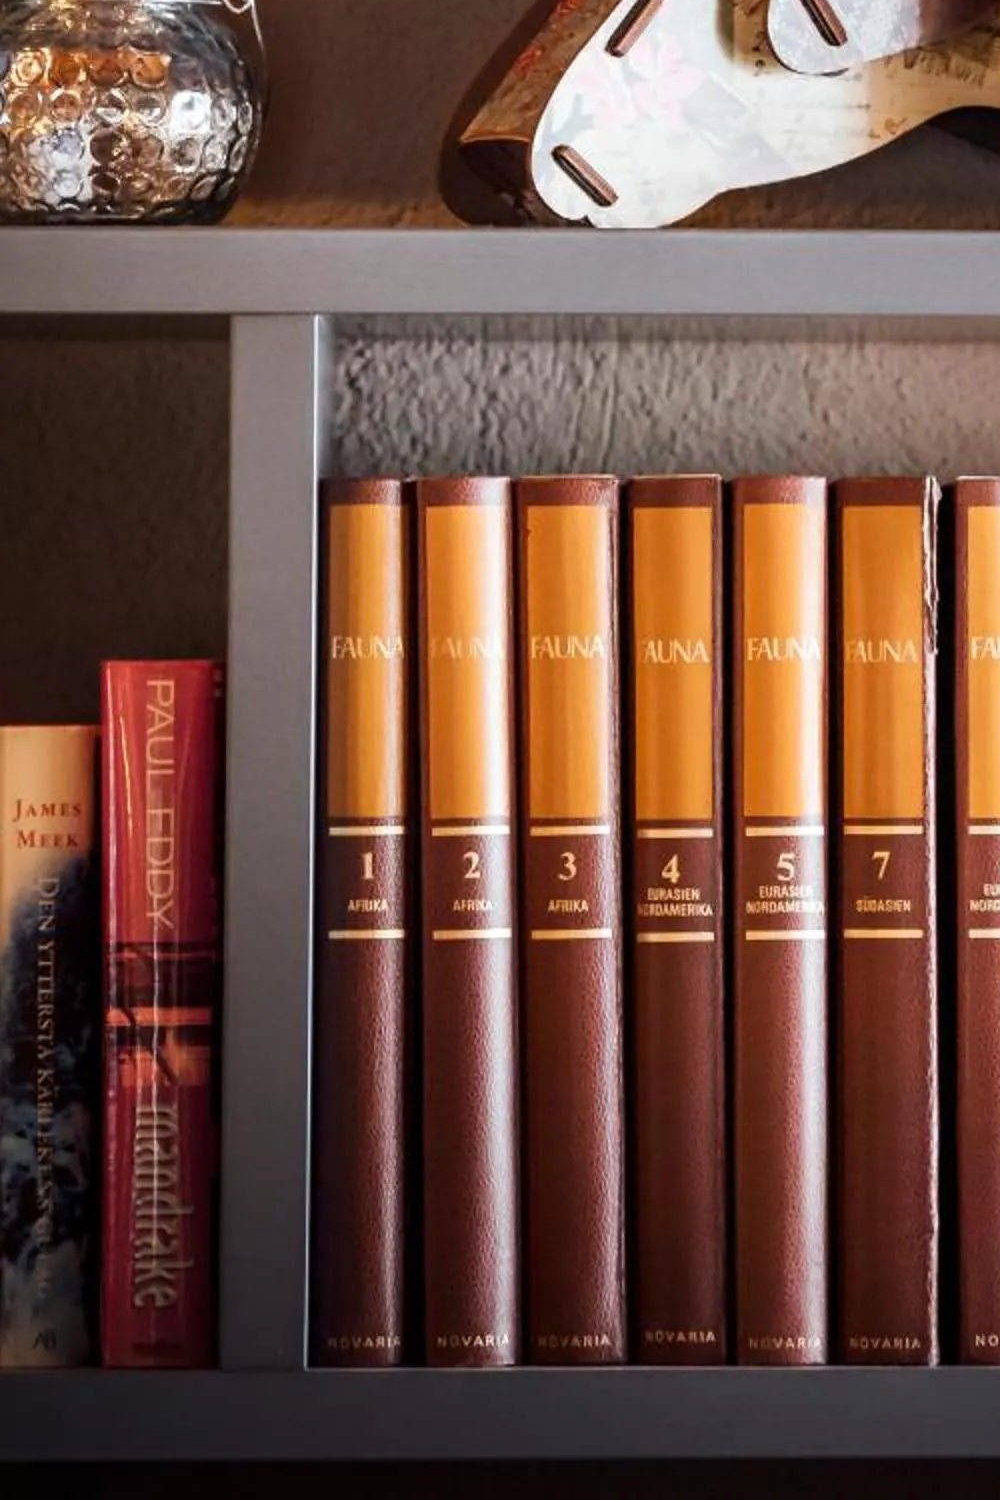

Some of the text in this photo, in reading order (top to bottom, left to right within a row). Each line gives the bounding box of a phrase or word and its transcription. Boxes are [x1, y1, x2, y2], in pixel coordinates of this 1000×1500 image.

[331, 635, 405, 660] FAUNA
[430, 635, 505, 660] FAUN
[530, 635, 606, 659] FAUNA
[641, 638, 710, 664] AUNA
[746, 636, 822, 661] FAUNA
[845, 638, 918, 663] FAUNA
[146, 680, 175, 929] PAUL EDDY
[361, 852, 375, 880] 1
[463, 851, 481, 879] 2
[558, 852, 577, 880] 3
[661, 853, 680, 884] 4
[776, 852, 796, 881] 5
[871, 851, 891, 880] 7
[347, 898, 390, 913] AFRIKA
[452, 898, 495, 913] AFRIKA
[547, 898, 589, 913] AFRIKA
[647, 887, 701, 901] EURASIEN
[745, 900, 825, 914] NORDAMEA
[134, 1105, 195, 1308] mandrake
[437, 1333, 510, 1348] NOVARIA
[538, 1333, 612, 1348] NOVARIA
[645, 1330, 716, 1343] NOVARIA
[749, 1336, 823, 1350] NOVARIA
[849, 1336, 921, 1350] NOVARIA
